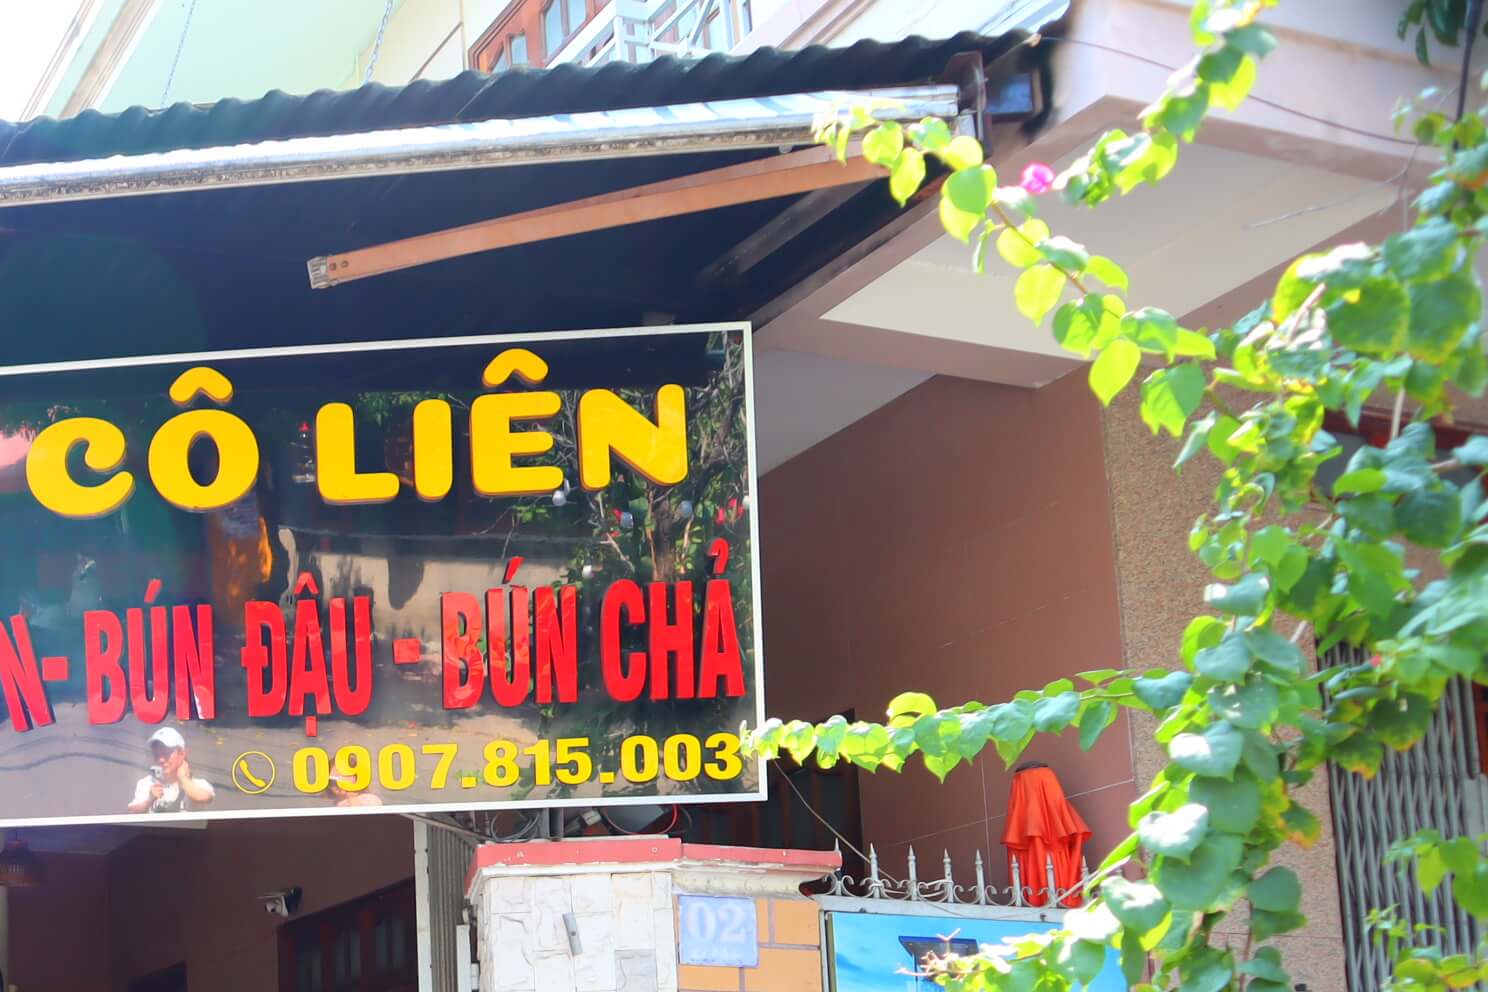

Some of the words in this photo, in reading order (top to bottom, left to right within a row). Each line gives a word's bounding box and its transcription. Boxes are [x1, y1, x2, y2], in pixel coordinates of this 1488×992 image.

[25, 367, 260, 518] CÔ
[315, 349, 689, 505] LIÊN
[85, 579, 216, 727] BÚN
[241, 572, 373, 738] ĐẬU
[441, 556, 578, 711] BÚN
[601, 538, 745, 702] CHẢ
[292, 732, 743, 795] 0907.815.003
[687, 902, 746, 943] 02
